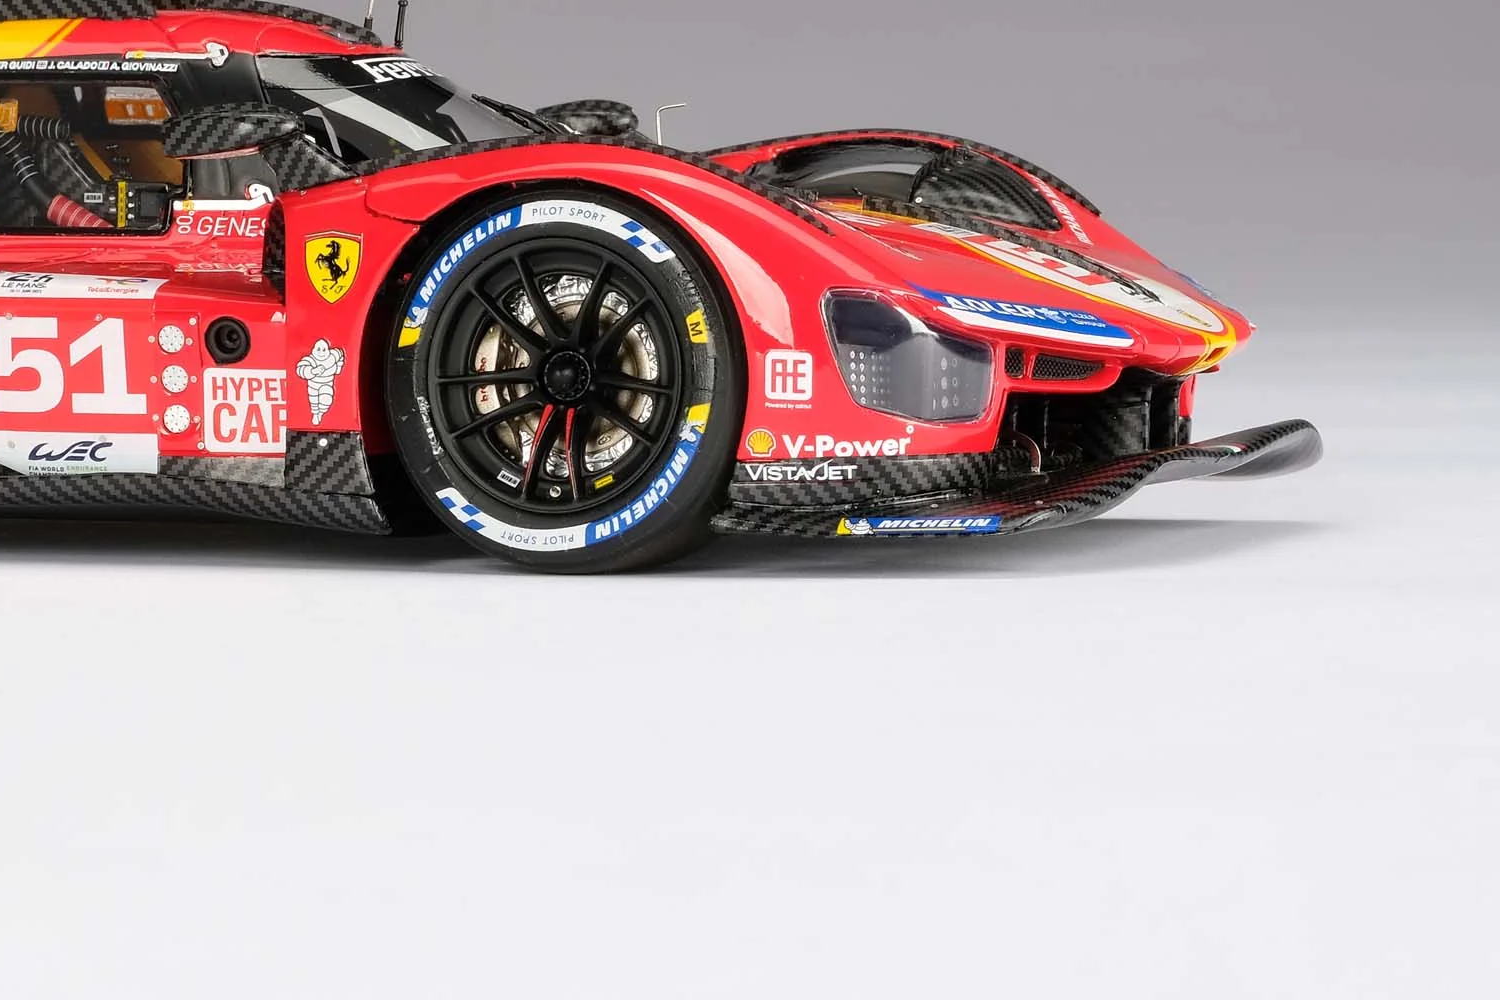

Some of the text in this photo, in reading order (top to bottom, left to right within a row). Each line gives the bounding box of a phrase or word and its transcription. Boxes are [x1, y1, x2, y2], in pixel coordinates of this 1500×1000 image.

[9, 61, 36, 70] GUIDI
[56, 61, 99, 70] CALADO
[121, 63, 179, 73] GIOVINAZZI
[531, 206, 606, 224] PILOT SPORT
[418, 213, 513, 304] MICHELIN
[943, 295, 1046, 320] ADLER
[689, 321, 703, 337] M
[28, 440, 113, 462] WEC
[782, 434, 912, 458] V-Power
[595, 447, 689, 541] MICHELIN
[876, 517, 993, 530] MICHELIN
[500, 530, 575, 546] PILOT SPORT
